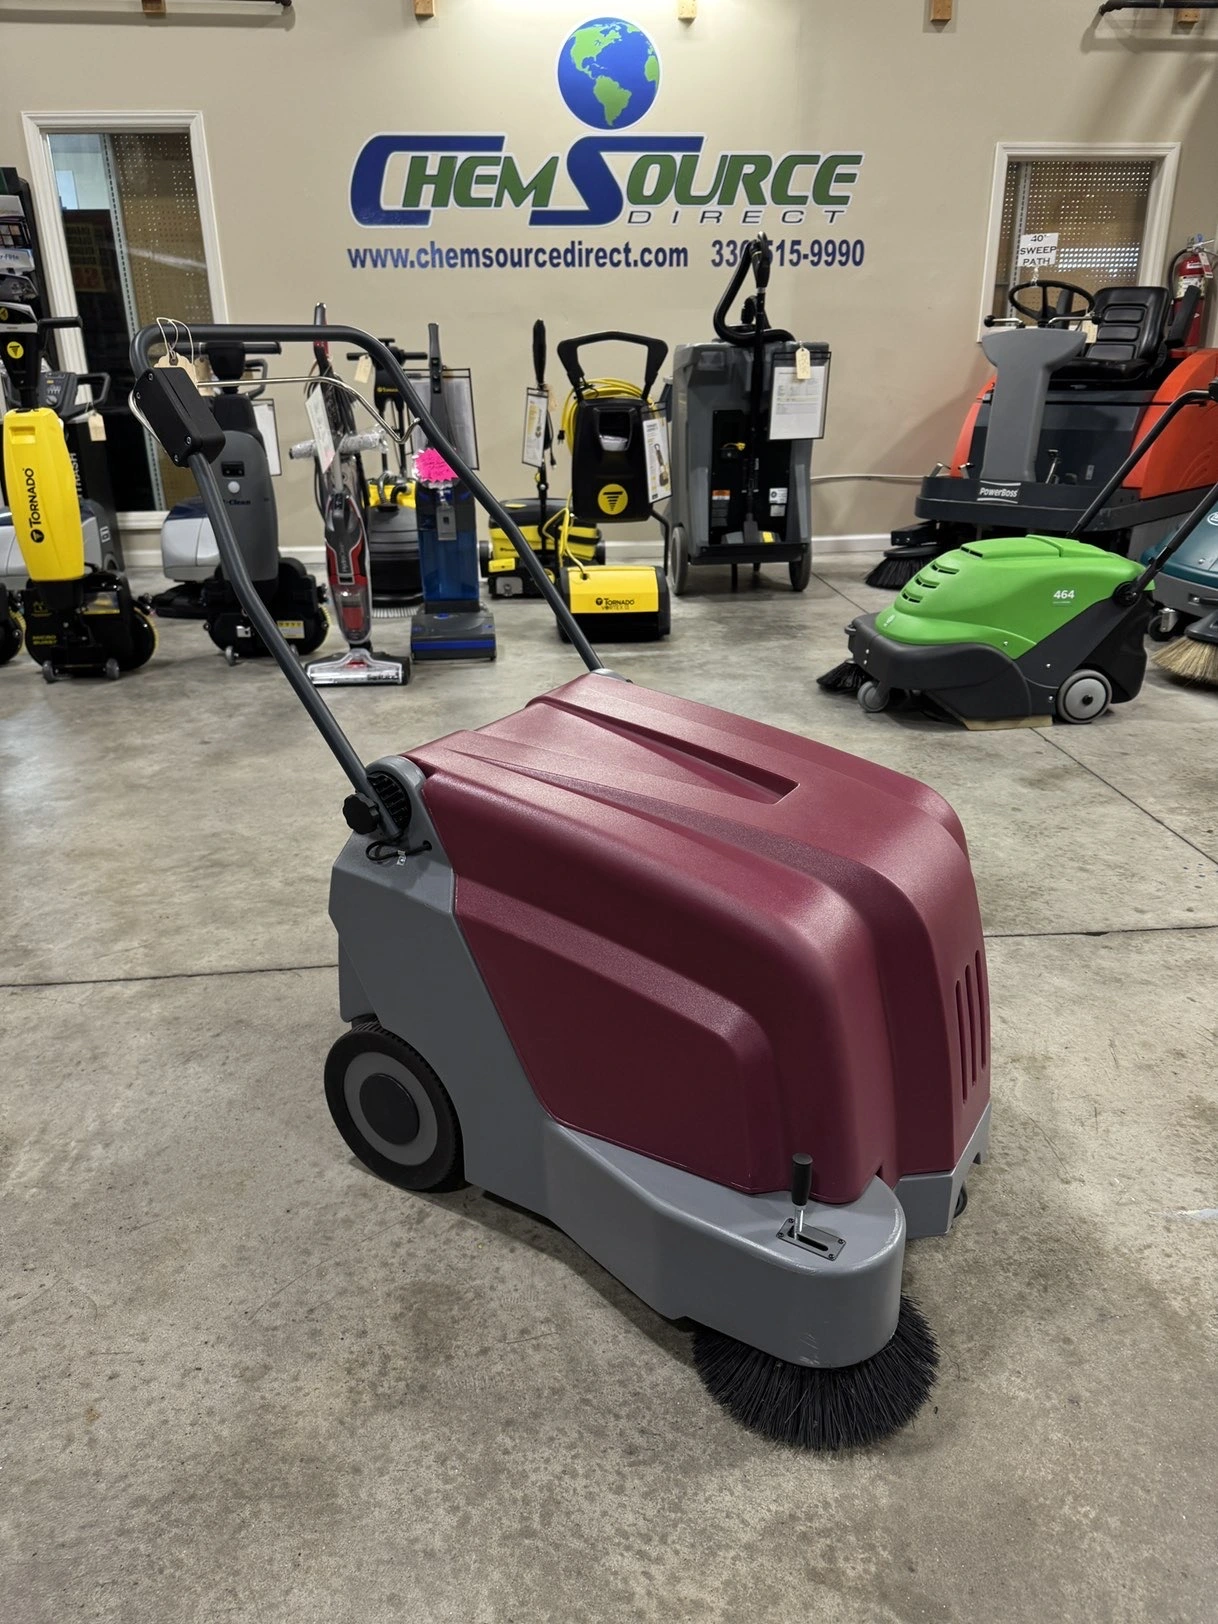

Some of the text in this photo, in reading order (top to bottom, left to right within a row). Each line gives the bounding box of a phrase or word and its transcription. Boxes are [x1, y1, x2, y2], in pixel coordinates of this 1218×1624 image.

[628, 210, 845, 224] DIRECT
[347, 240, 688, 268] www.chemsourcedirect.com
[1020, 245, 1057, 255] SWEEP
[1023, 257, 1051, 265] PATH
[979, 487, 1019, 497] PowerBoss
[24, 467, 42, 529] TORNADO
[1053, 589, 1075, 599] 464
